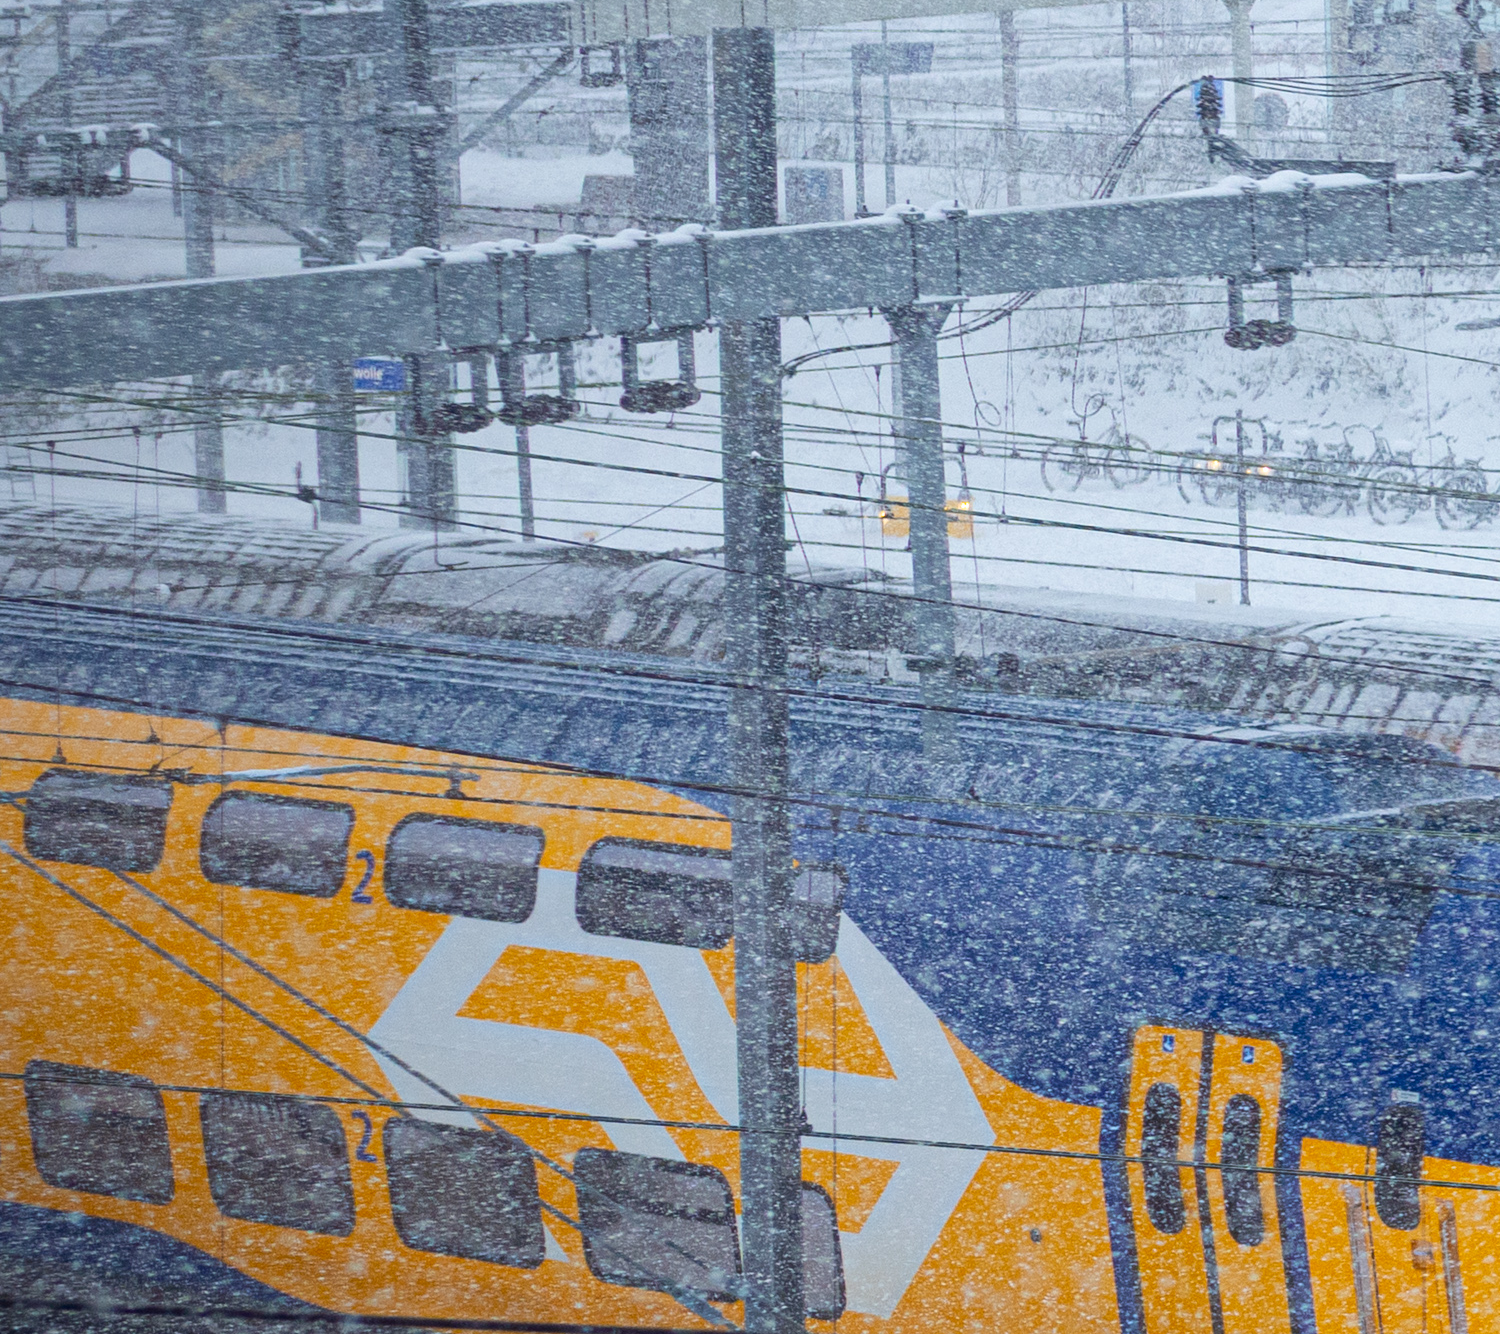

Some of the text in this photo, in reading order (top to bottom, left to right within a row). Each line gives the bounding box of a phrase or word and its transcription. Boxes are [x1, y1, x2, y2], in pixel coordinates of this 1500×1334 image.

[353, 366, 384, 380] wolle
[351, 850, 376, 904] 2
[351, 1109, 378, 1162] 2
